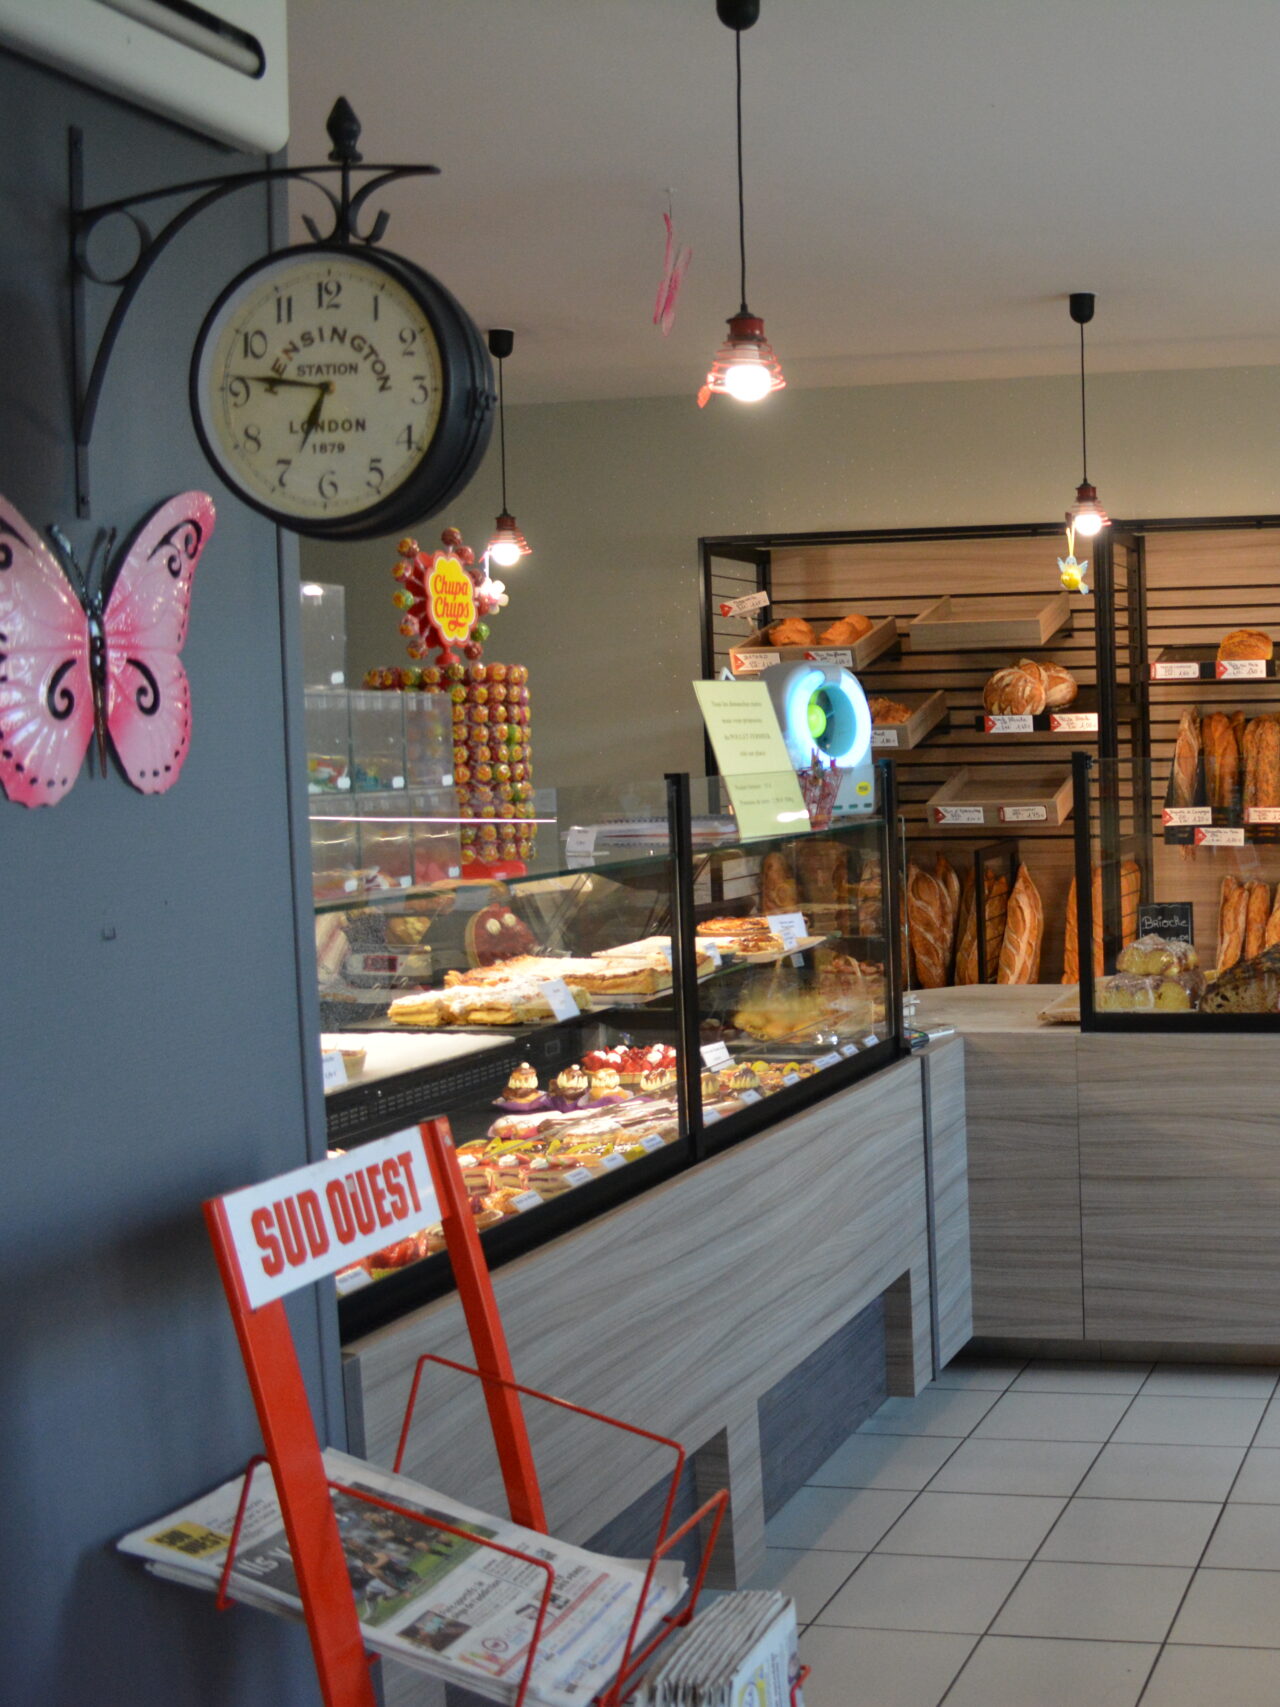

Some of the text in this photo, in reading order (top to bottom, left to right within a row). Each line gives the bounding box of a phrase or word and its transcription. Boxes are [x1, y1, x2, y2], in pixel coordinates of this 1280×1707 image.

[276, 295, 293, 323] 11
[317, 280, 342, 310] 12
[243, 329, 268, 359] 10
[399, 327, 417, 357] 2
[264, 325, 392, 395] KENSINGTON
[297, 363, 358, 377] STATION
[229, 376, 250, 407] 9
[411, 376, 428, 405] 3
[243, 424, 262, 453] 8
[289, 419, 366, 434] LONDON
[396, 424, 418, 451] 4
[312, 442, 346, 454] 1879
[276, 459, 292, 487] 7
[318, 471, 338, 500] 6
[366, 458, 384, 489] 5
[433, 574, 469, 602] Chupa
[434, 597, 470, 632] Chups
[251, 1150, 422, 1279] SUD OUEST
